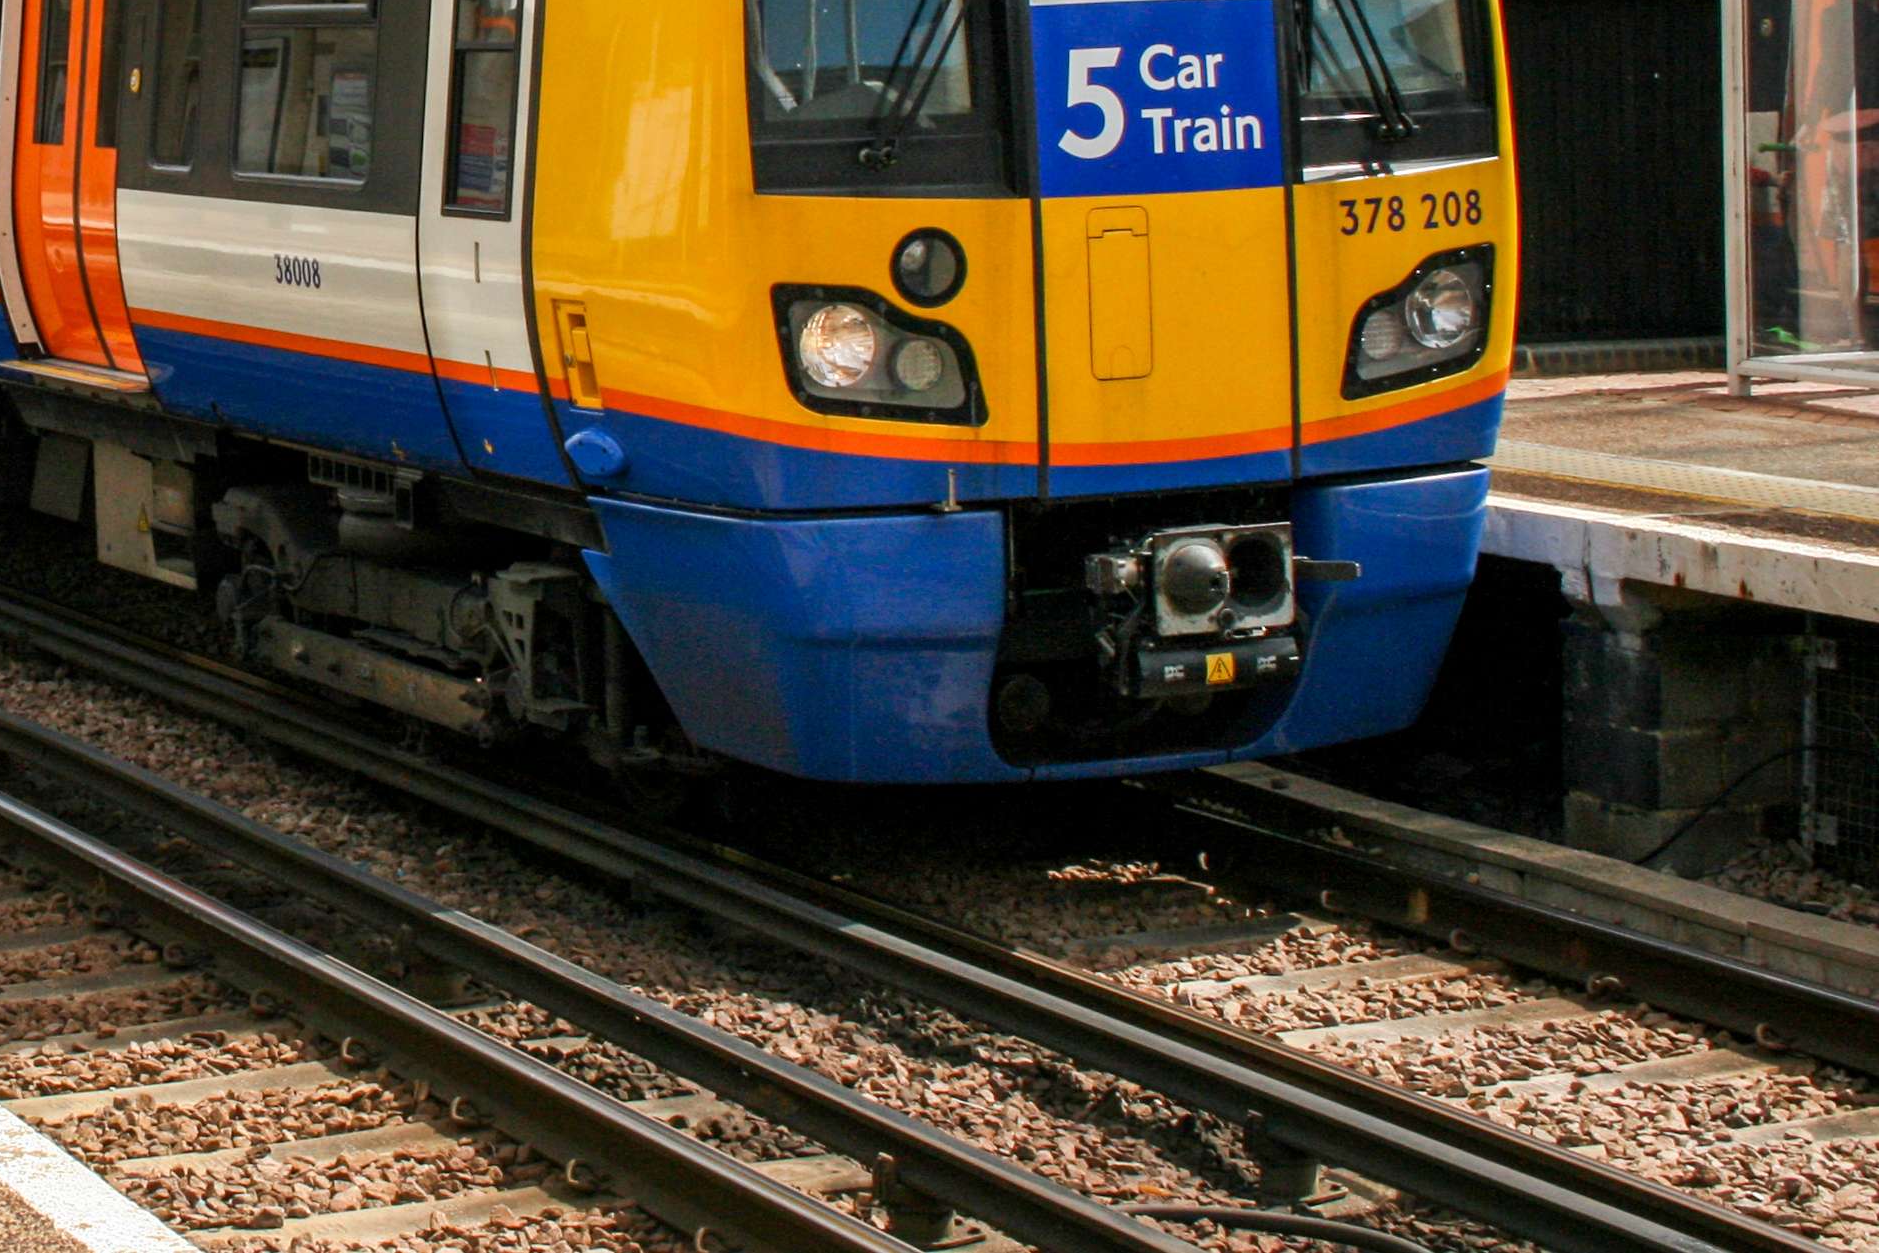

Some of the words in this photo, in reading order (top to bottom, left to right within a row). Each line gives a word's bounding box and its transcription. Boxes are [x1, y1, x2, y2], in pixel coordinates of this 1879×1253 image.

[1058, 47, 1125, 160] 5
[1139, 43, 1223, 91] Car
[1141, 104, 1262, 154] Train
[1339, 196, 1405, 236] 378
[1421, 189, 1482, 229] 208
[274, 254, 321, 288] 38008
